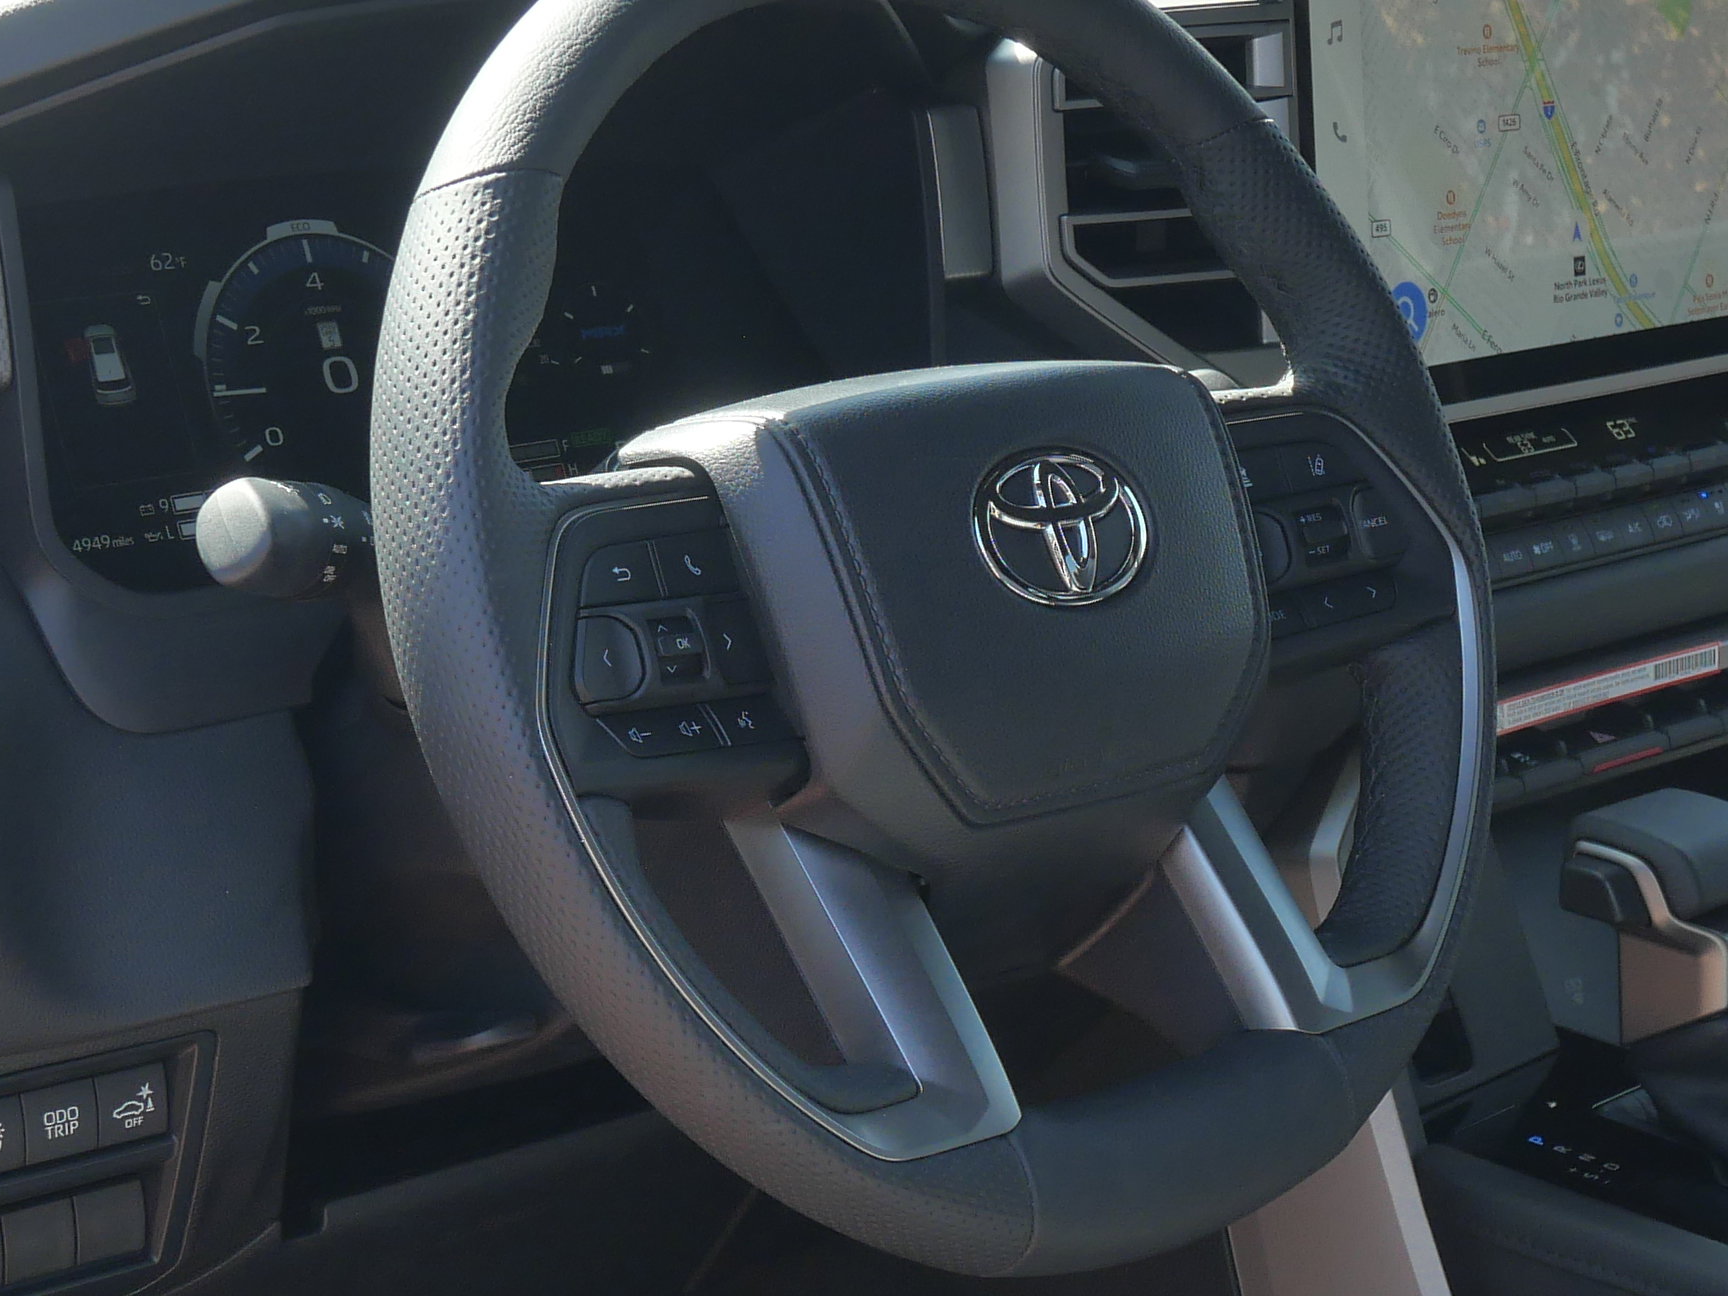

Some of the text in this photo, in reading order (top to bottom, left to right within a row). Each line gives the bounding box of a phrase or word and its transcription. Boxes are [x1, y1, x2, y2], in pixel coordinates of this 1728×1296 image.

[291, 222, 311, 233] ECO
[1375, 223, 1387, 233] 495
[306, 272, 324, 291] 4
[1554, 276, 1607, 291] North Park Lexus
[1553, 293, 1563, 303] Rio
[1564, 290, 1588, 301] Grande
[1589, 287, 1608, 299] Valley
[245, 325, 264, 345] 2
[322, 356, 359, 394] 0
[265, 427, 283, 446] 0
[159, 499, 169, 512] 9
[72, 534, 135, 553] 4949 miles
[676, 637, 691, 649] OK
[43, 1106, 80, 1127] ODO
[124, 1115, 145, 1129] OFF
[44, 1120, 80, 1140] TRIP
[1528, 1135, 1544, 1146] P
